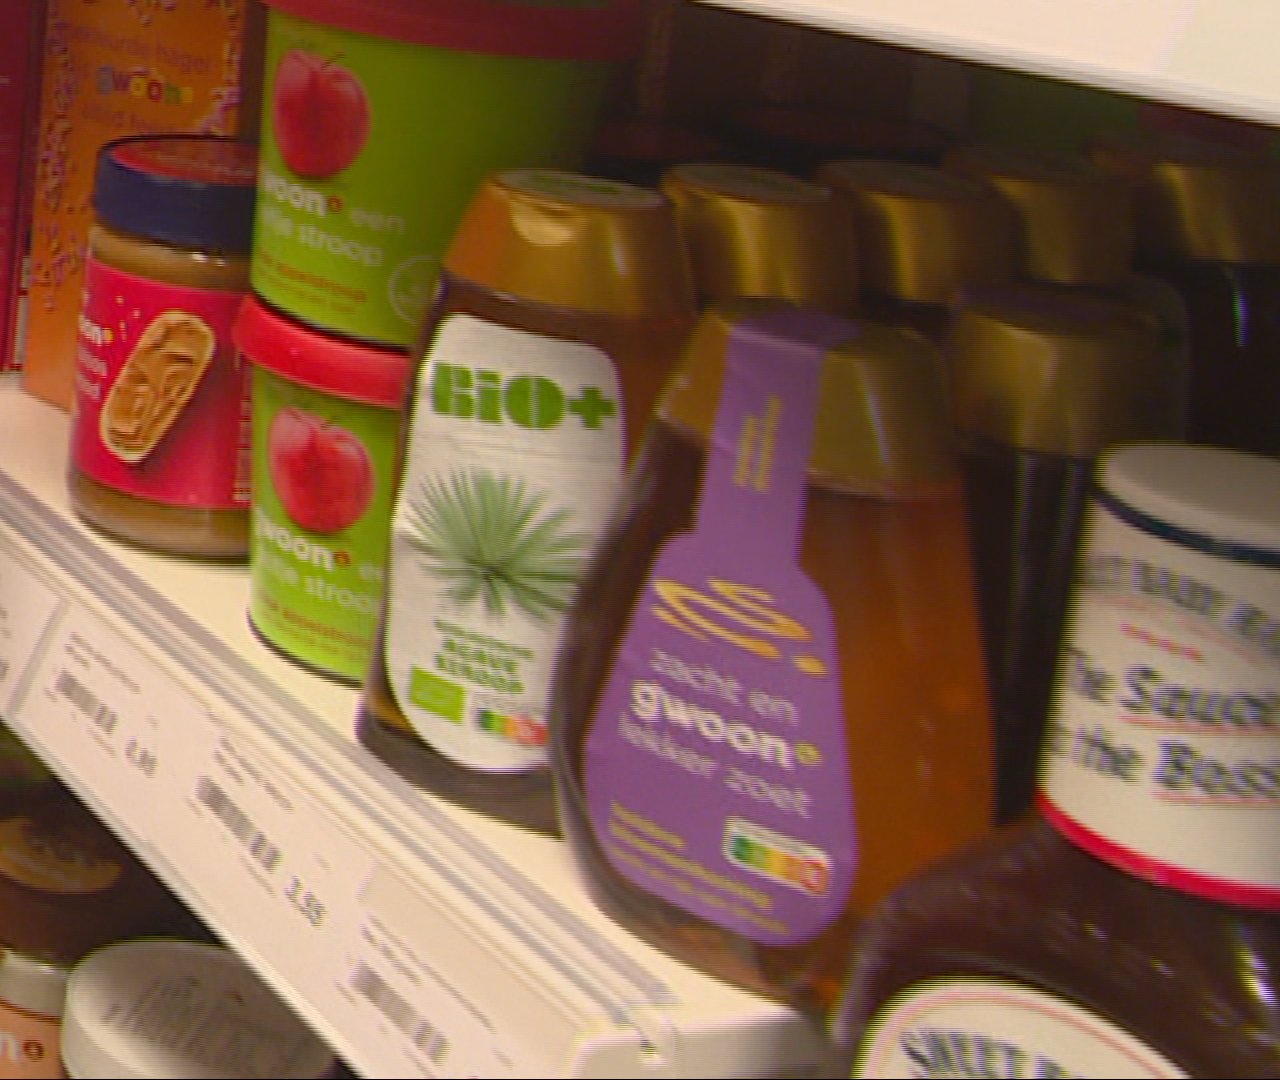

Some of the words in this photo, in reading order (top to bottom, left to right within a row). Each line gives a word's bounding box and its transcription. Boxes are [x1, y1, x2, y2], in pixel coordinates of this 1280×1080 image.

[259, 170, 329, 219] woon
[296, 220, 385, 268] stroop
[630, 679, 794, 770] gwoon
